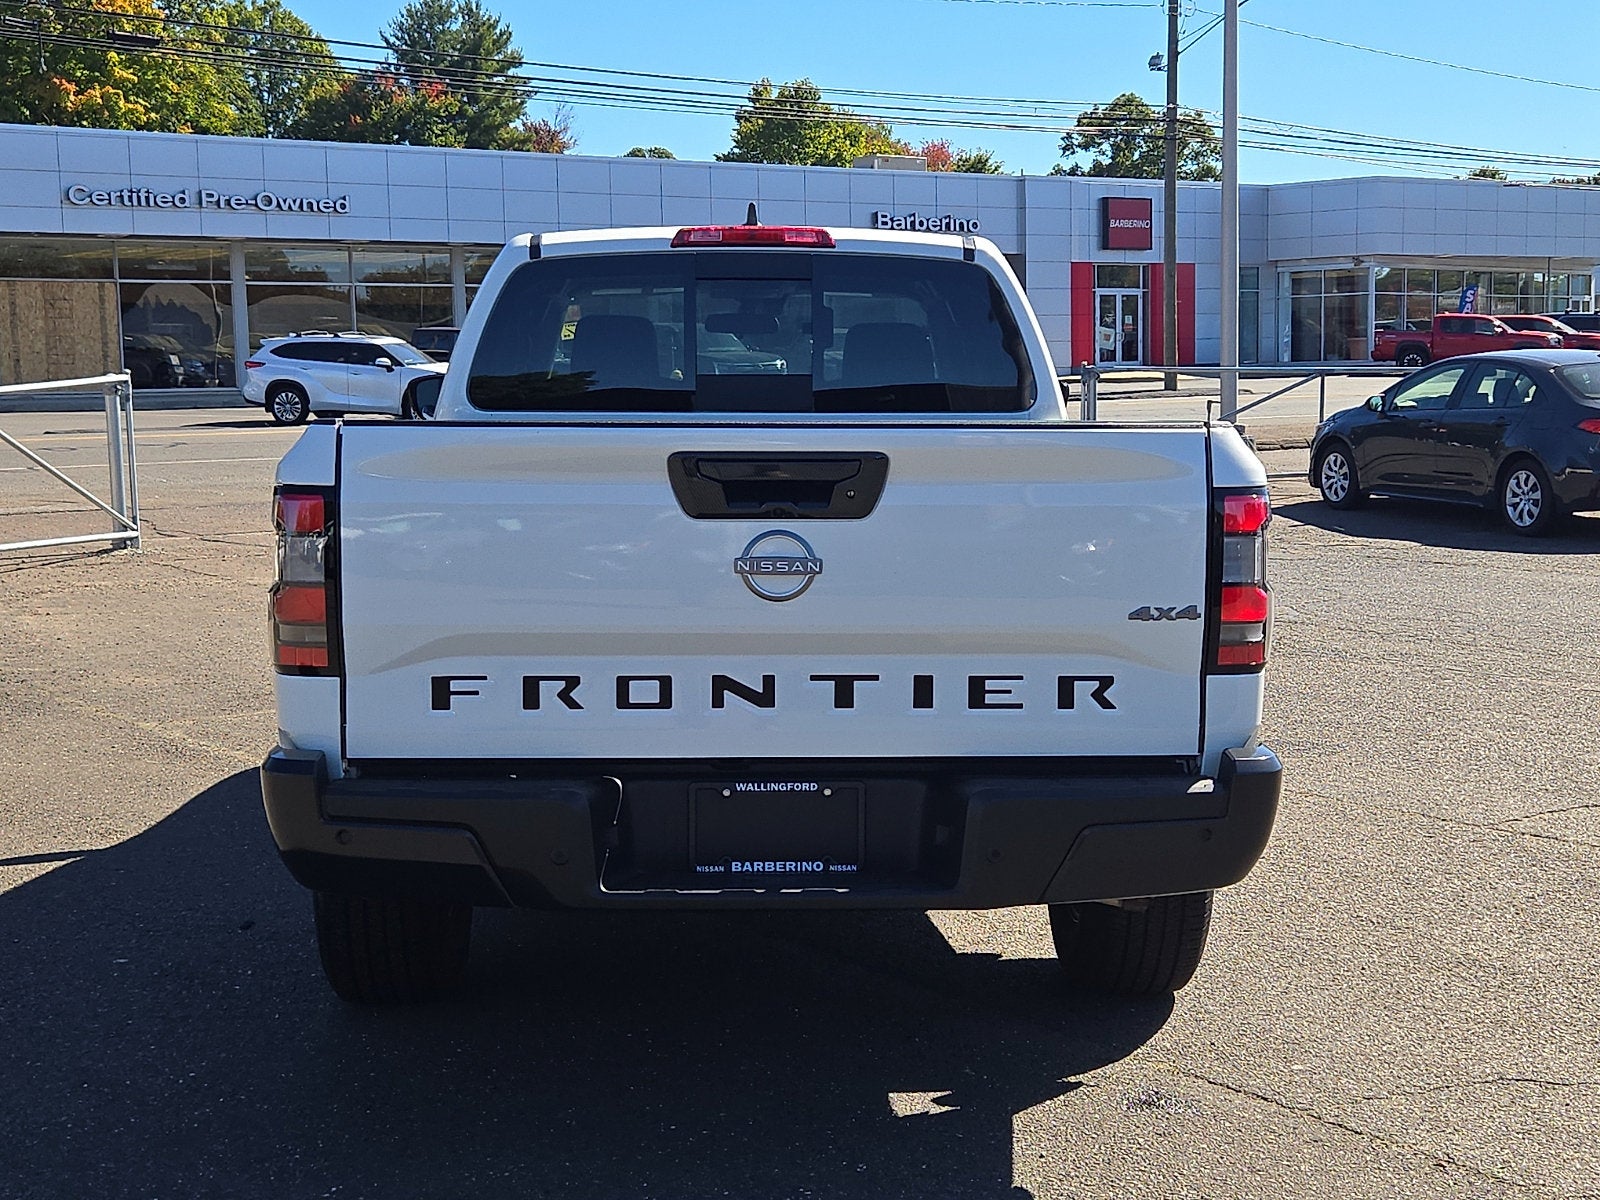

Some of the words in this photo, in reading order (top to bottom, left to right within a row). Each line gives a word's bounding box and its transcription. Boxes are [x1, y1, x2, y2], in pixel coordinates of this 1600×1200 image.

[67, 184, 191, 208] Certified
[199, 189, 351, 214] Pre-Owned
[874, 211, 981, 233] Barberino
[1109, 218, 1151, 229] BARBERINO
[737, 560, 820, 572] NISSAN
[429, 673, 1119, 711] FRONTIER
[735, 782, 818, 792] WALLINGFORD
[696, 865, 725, 873] NISSAN
[731, 861, 824, 872] BARBERINO
[829, 864, 857, 872] NISSAN
